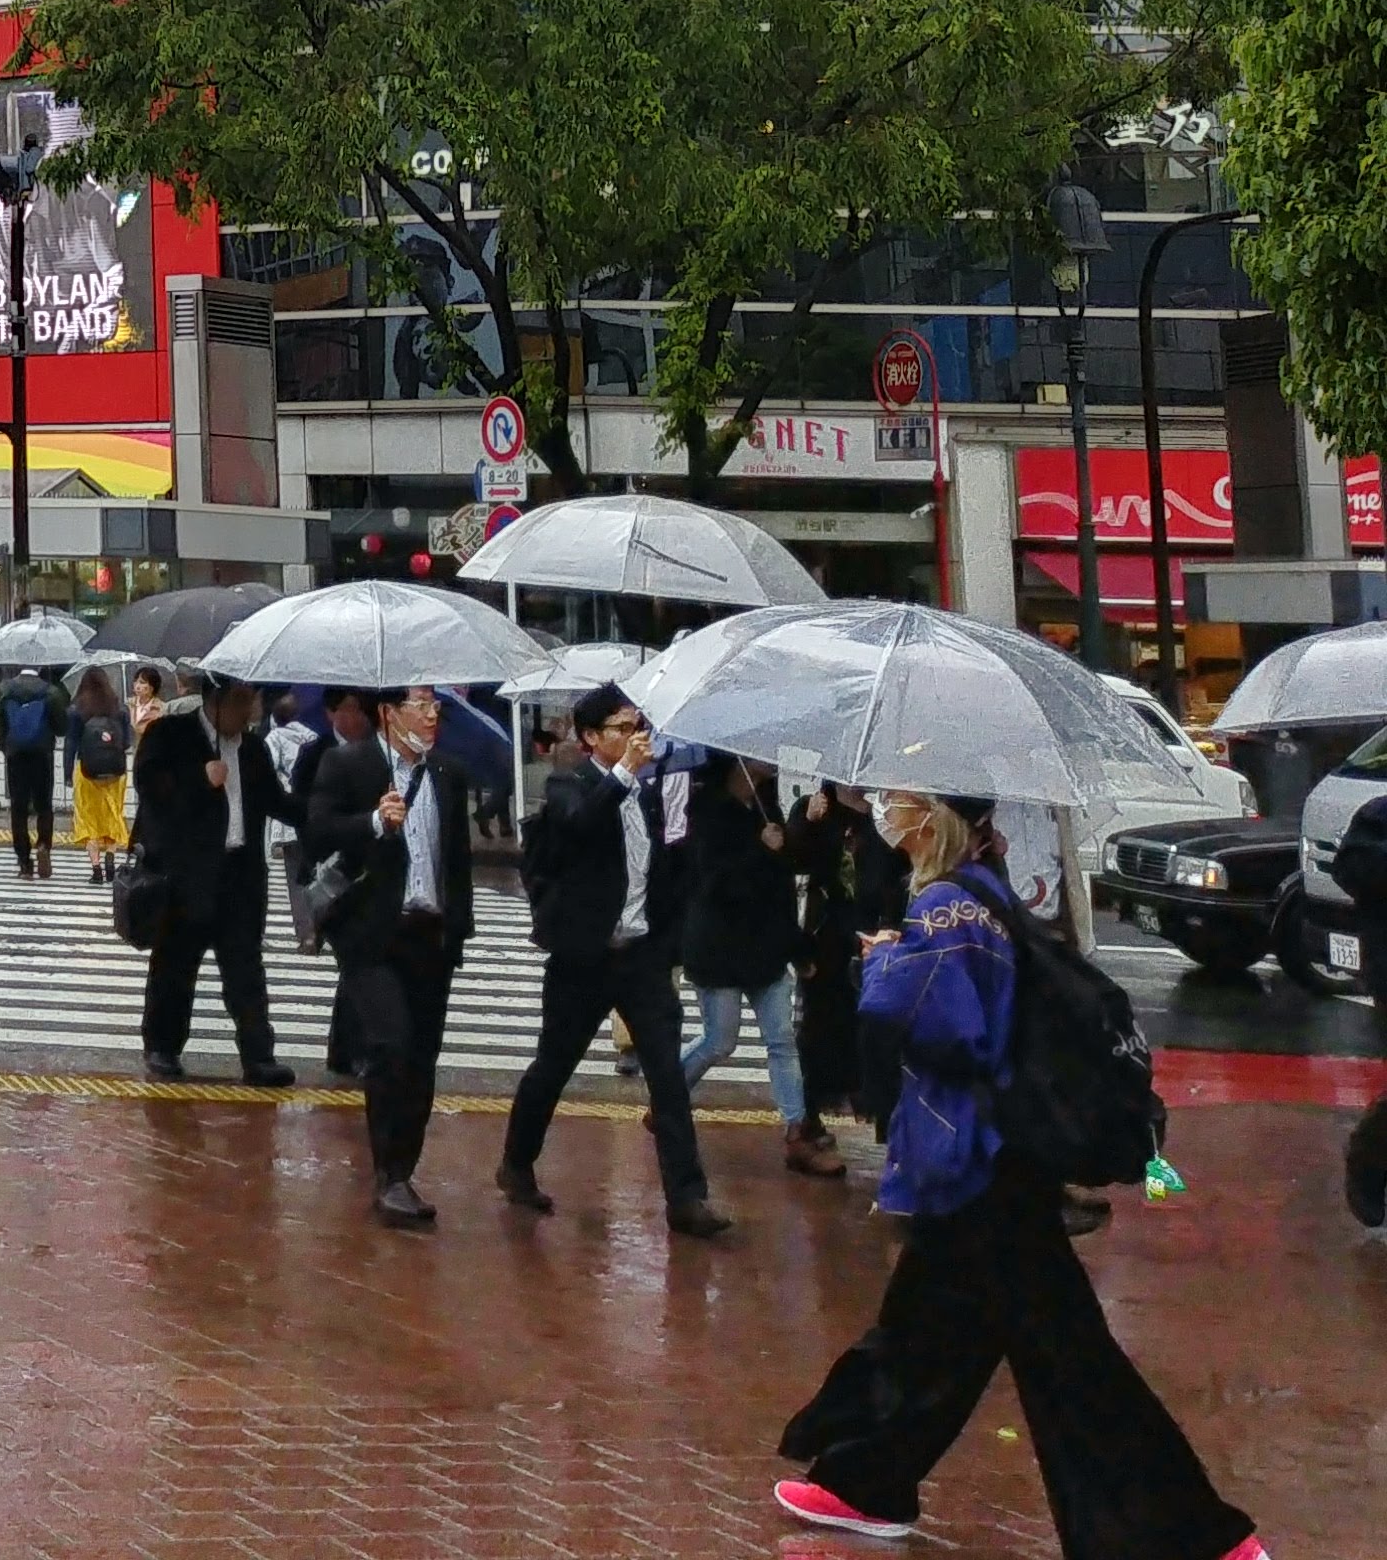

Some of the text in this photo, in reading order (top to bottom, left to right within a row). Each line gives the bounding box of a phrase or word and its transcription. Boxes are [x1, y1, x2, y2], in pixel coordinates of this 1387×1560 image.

[33, 308, 113, 342] BAND
[887, 361, 919, 386] 消火栓
